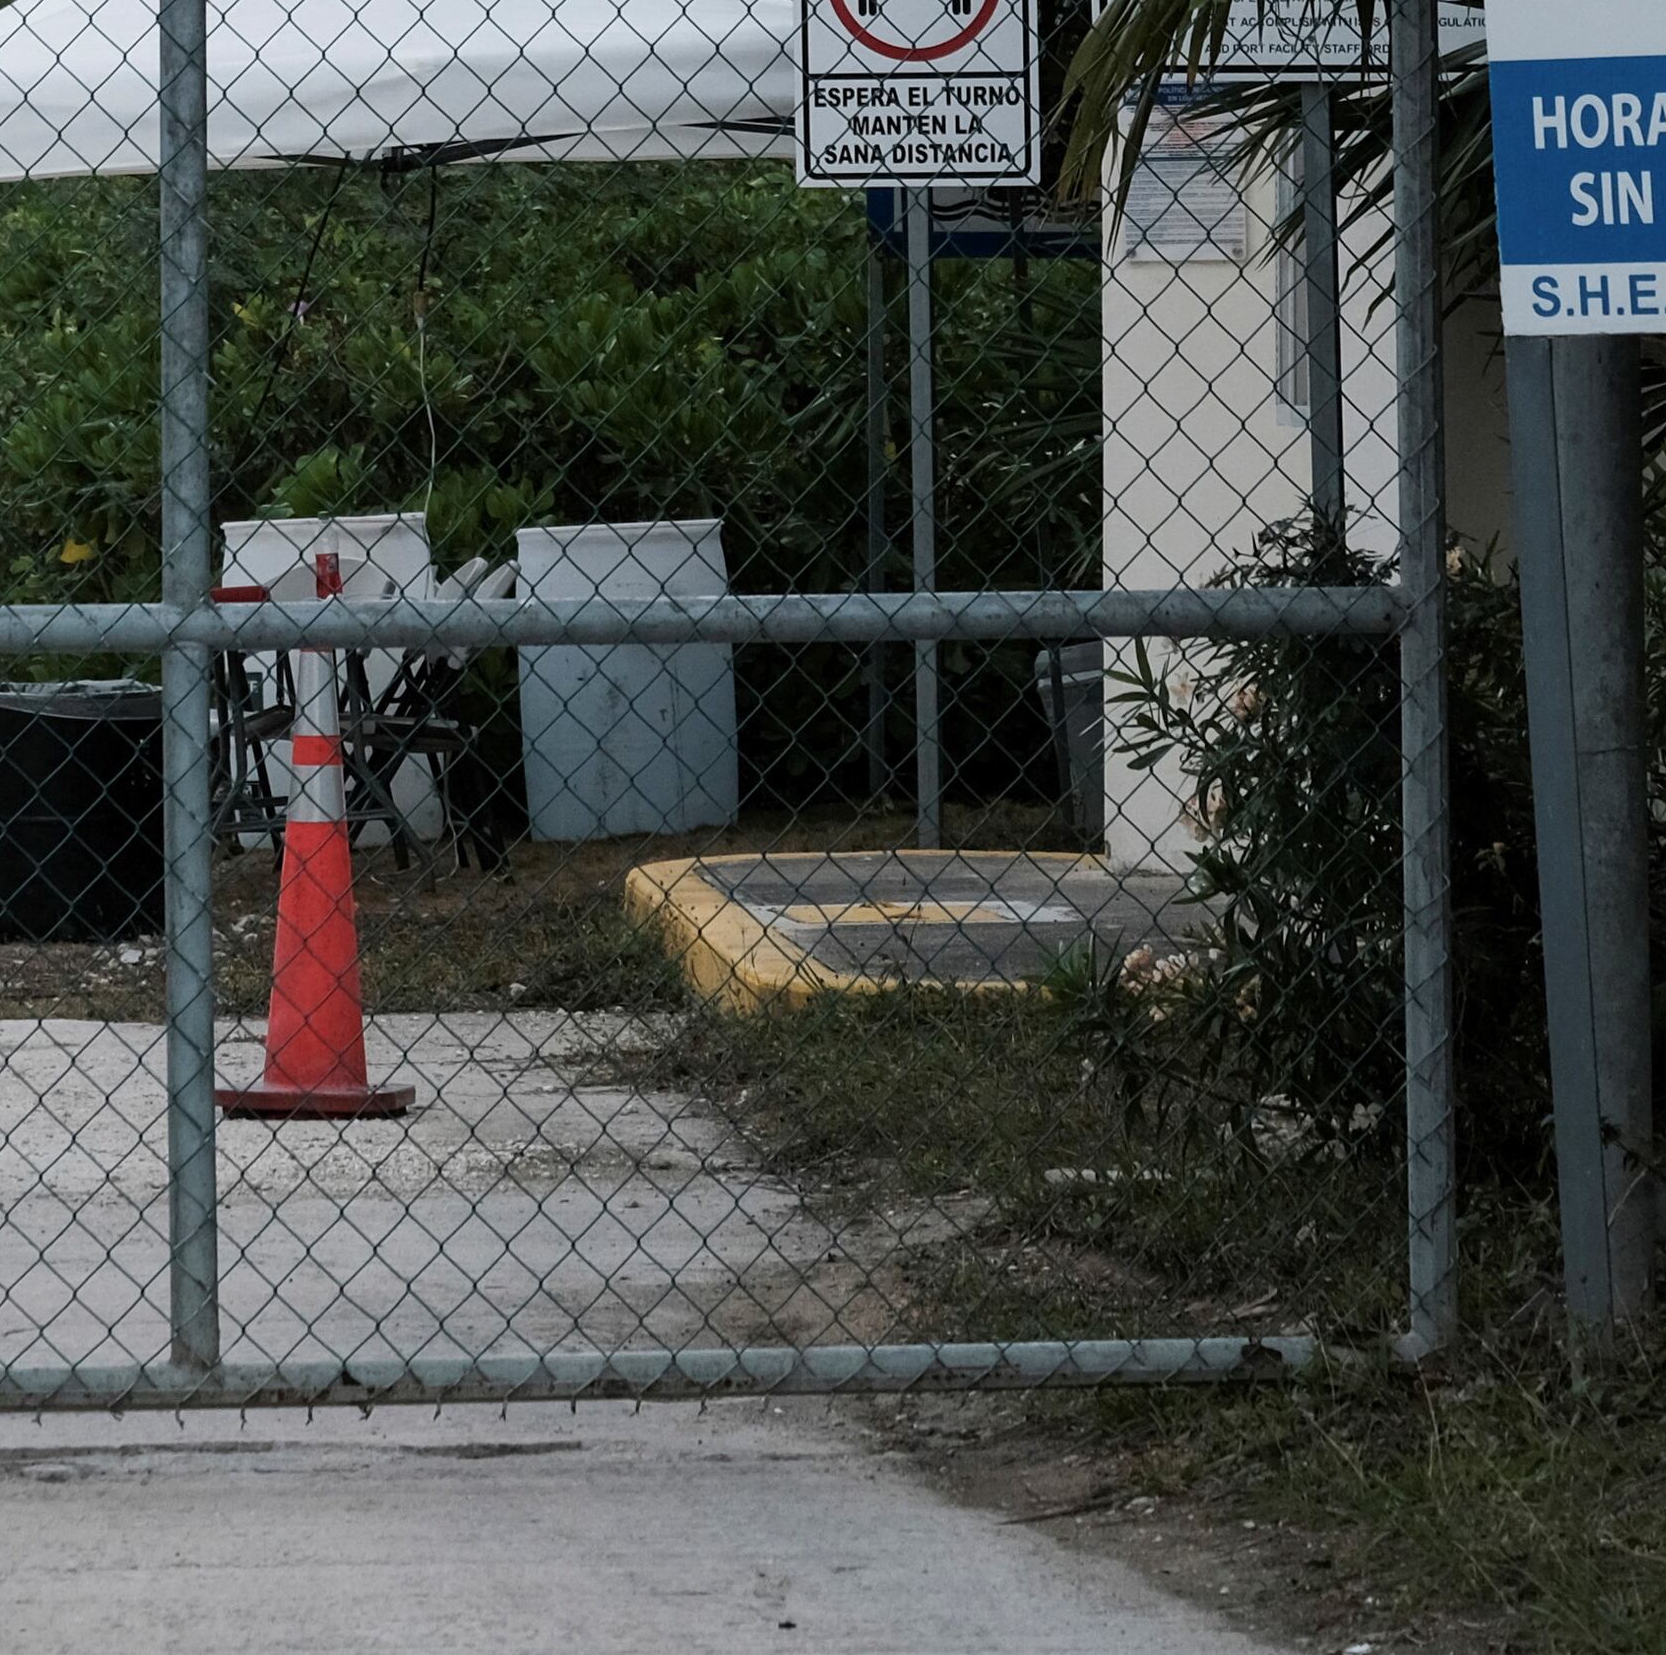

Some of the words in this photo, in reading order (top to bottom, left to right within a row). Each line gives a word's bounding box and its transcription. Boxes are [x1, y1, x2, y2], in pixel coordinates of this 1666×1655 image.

[814, 86, 900, 108] ESPERA
[908, 86, 934, 107] EL
[942, 86, 1020, 106] TURNO
[852, 115, 947, 136] MANTEN
[955, 114, 983, 135] LA
[824, 143, 883, 165] SANA
[892, 142, 1012, 164] DISTANCIA
[1569, 170, 1655, 227] SIN
